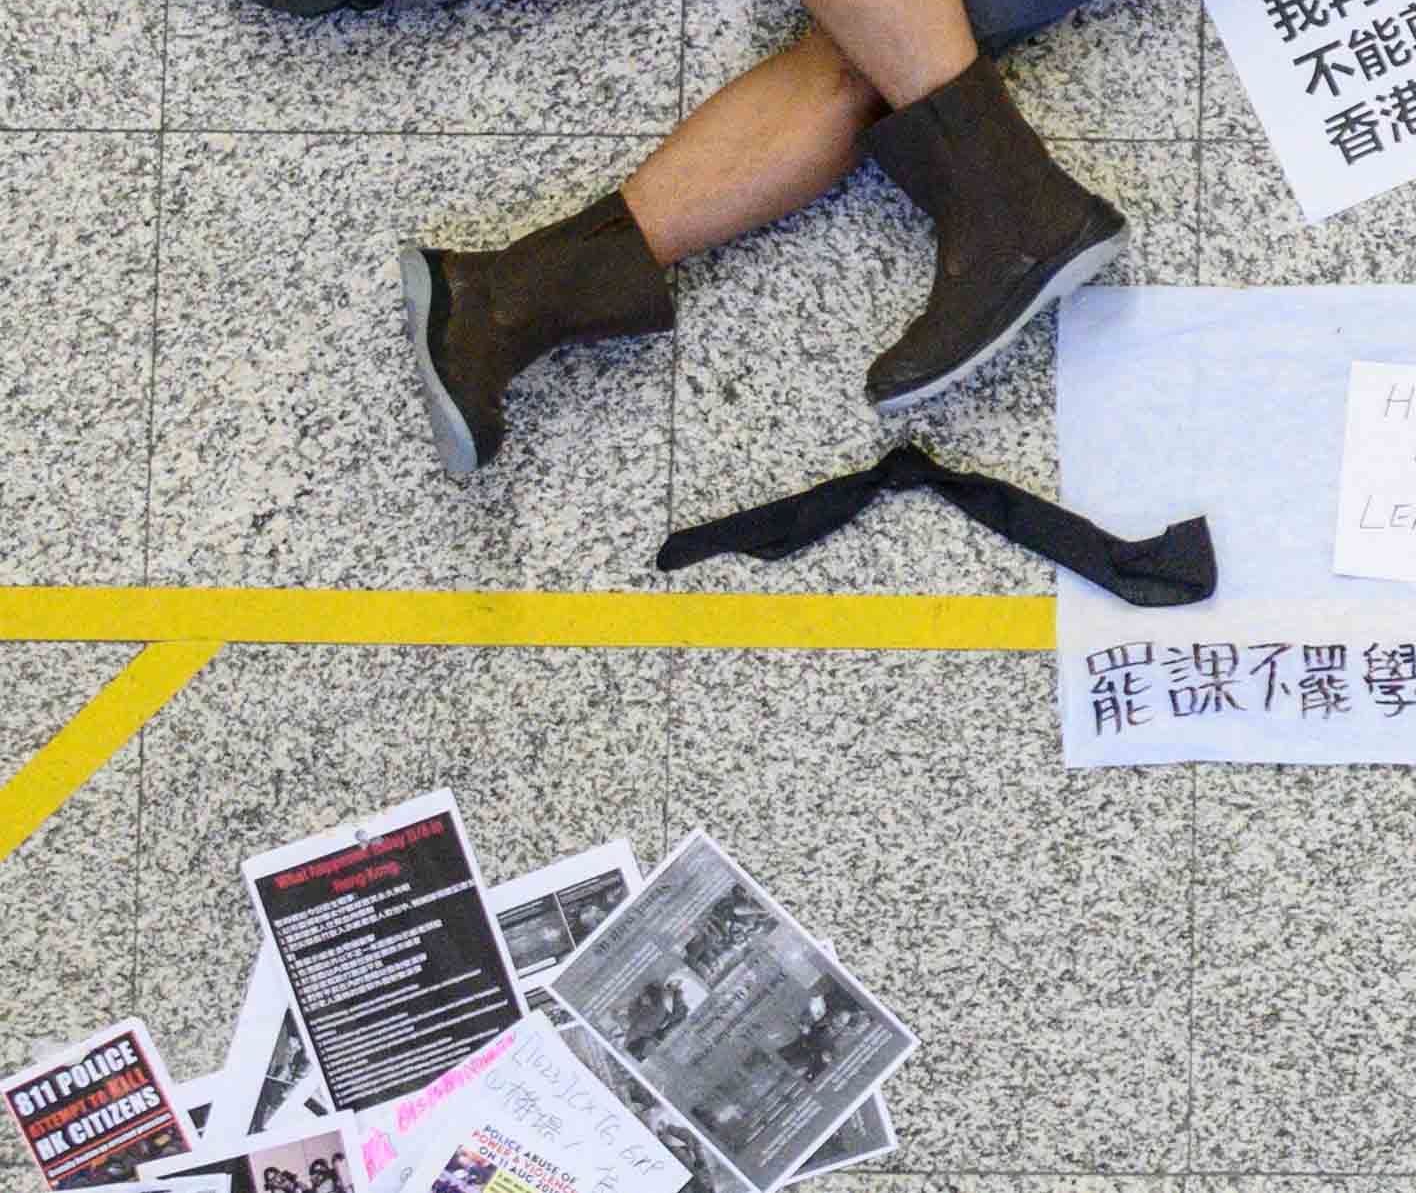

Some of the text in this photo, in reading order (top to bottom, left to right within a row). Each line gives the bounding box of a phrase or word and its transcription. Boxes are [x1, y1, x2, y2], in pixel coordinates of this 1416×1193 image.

[13, 1040, 138, 1117] 811 POLICE
[34, 1129, 71, 1161] HK
[66, 1086, 162, 1145] CITIZENS
[523, 1151, 562, 1177] ABUSE
